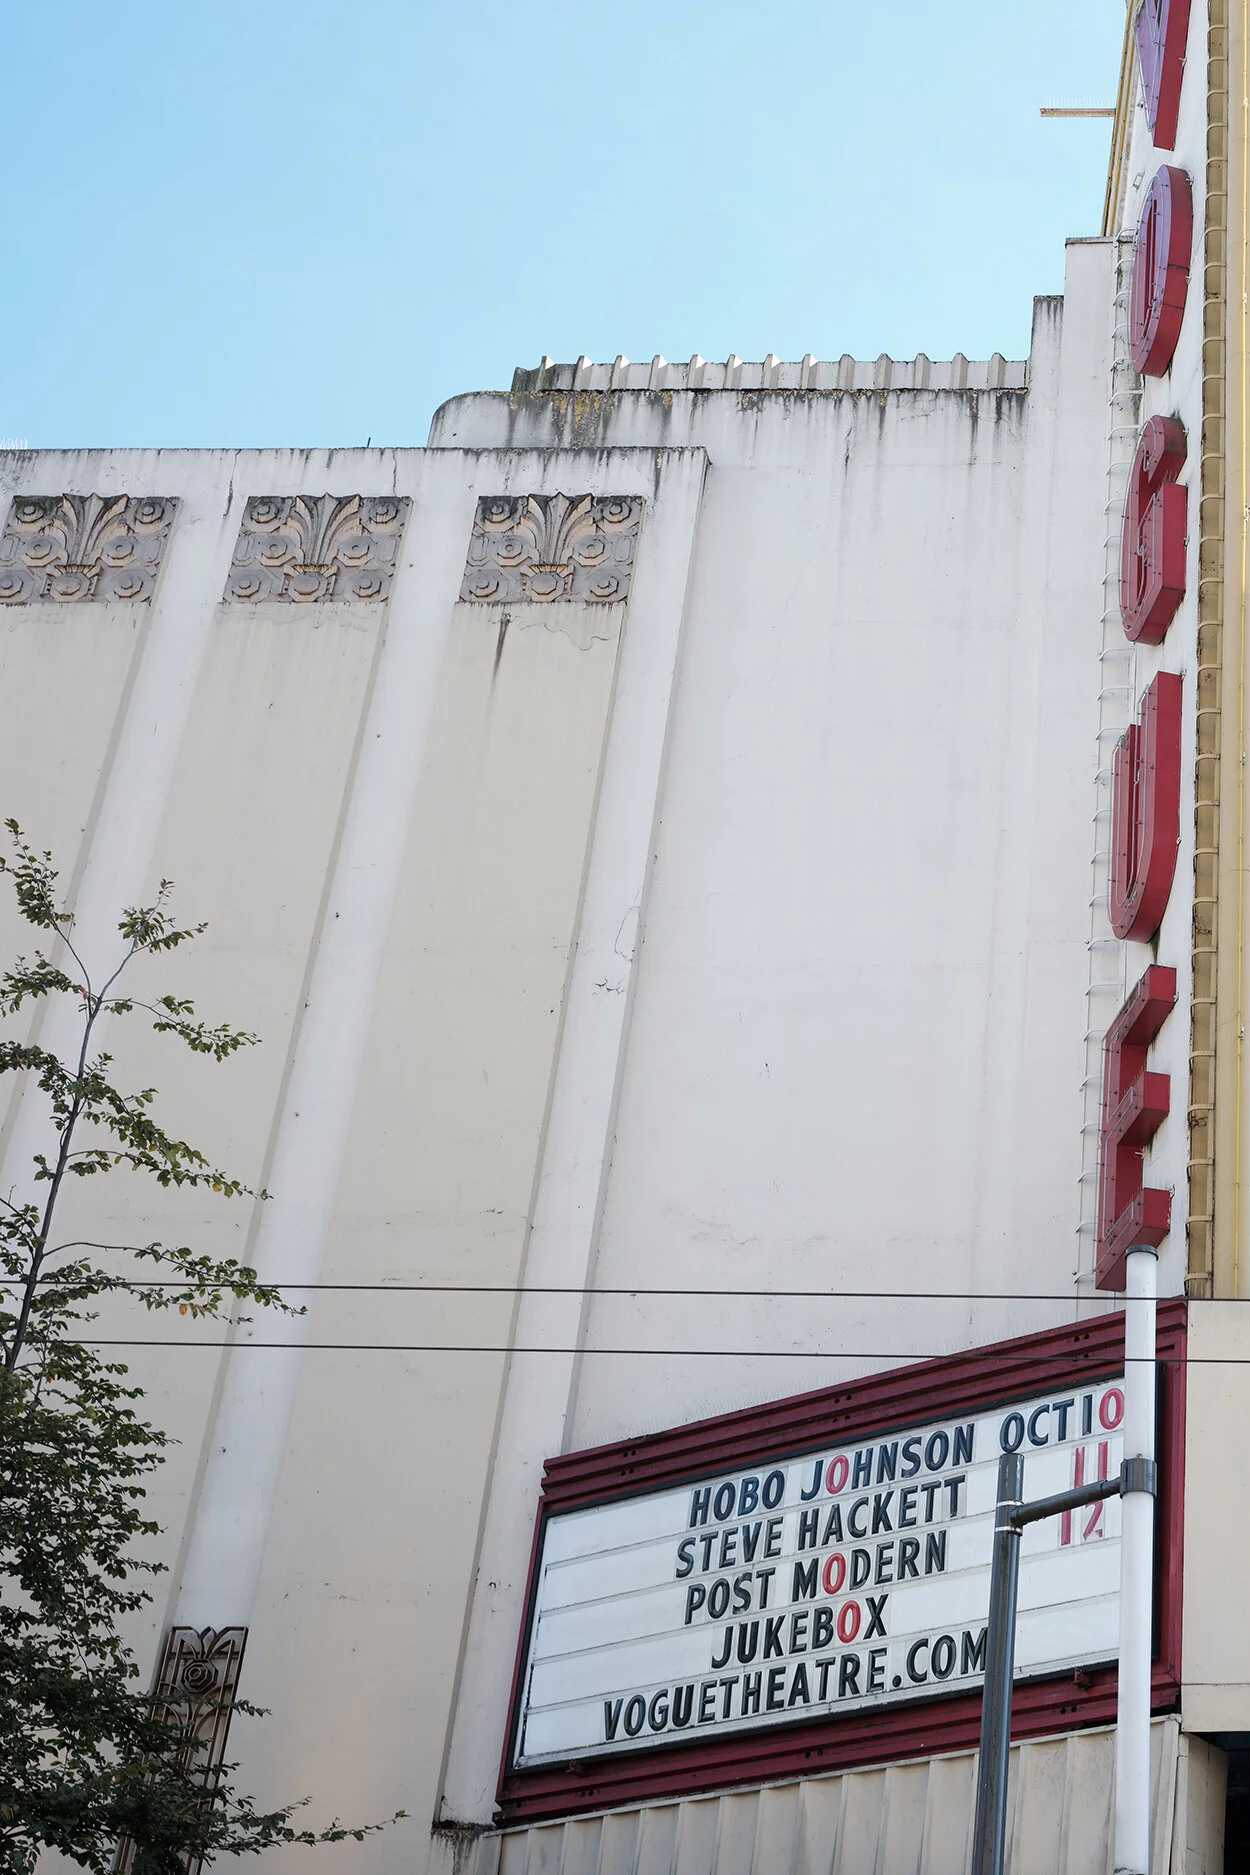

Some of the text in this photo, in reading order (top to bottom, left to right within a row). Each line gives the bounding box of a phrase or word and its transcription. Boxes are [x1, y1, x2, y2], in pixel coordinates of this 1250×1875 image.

[676, 1516, 784, 1578] STEVE
[798, 1474, 966, 1551] HACKETT
[690, 1470, 785, 1528] HOBO
[801, 1423, 975, 1501] JOHNSON
[685, 1500, 1103, 1625] POST MODERN 12
[604, 1627, 988, 1740] VOGUETHEATRE.COM
[711, 1594, 889, 1669] JUKEBOX
